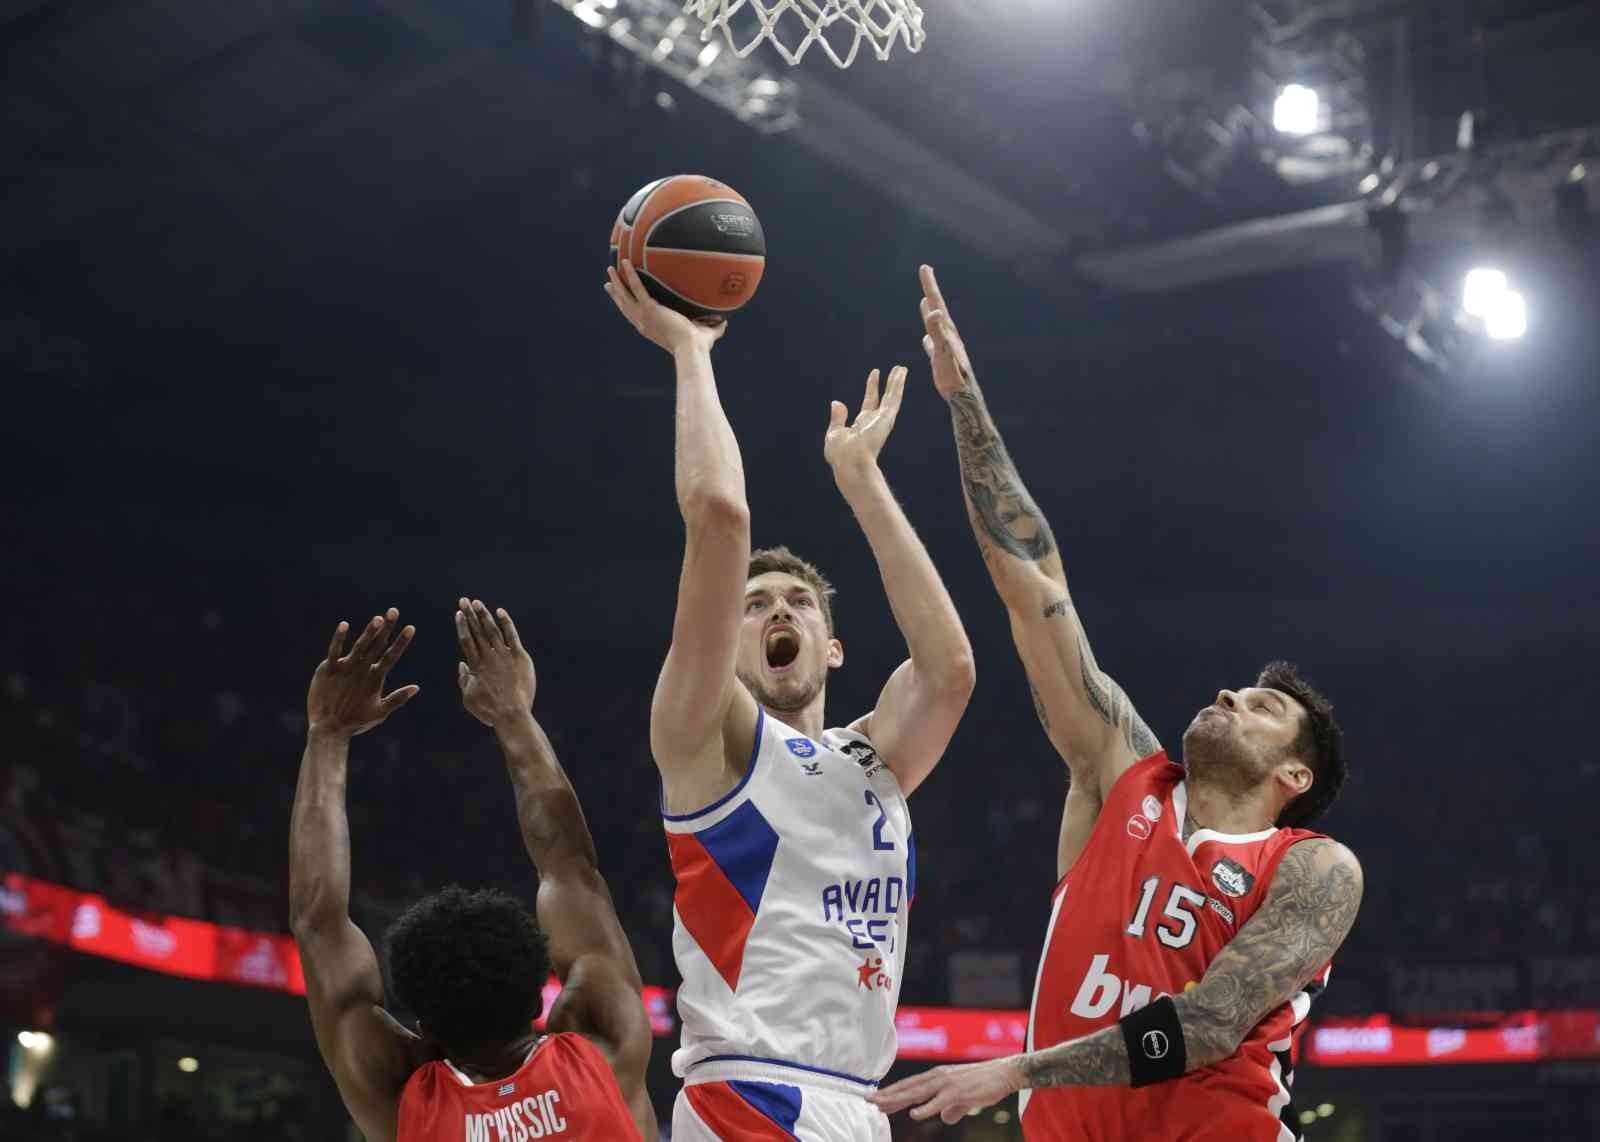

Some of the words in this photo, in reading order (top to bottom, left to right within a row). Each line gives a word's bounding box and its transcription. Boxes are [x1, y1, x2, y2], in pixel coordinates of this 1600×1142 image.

[864, 789, 895, 850] 2
[1125, 875, 1207, 950] 15
[464, 1089, 568, 1142] MCKISSIC
